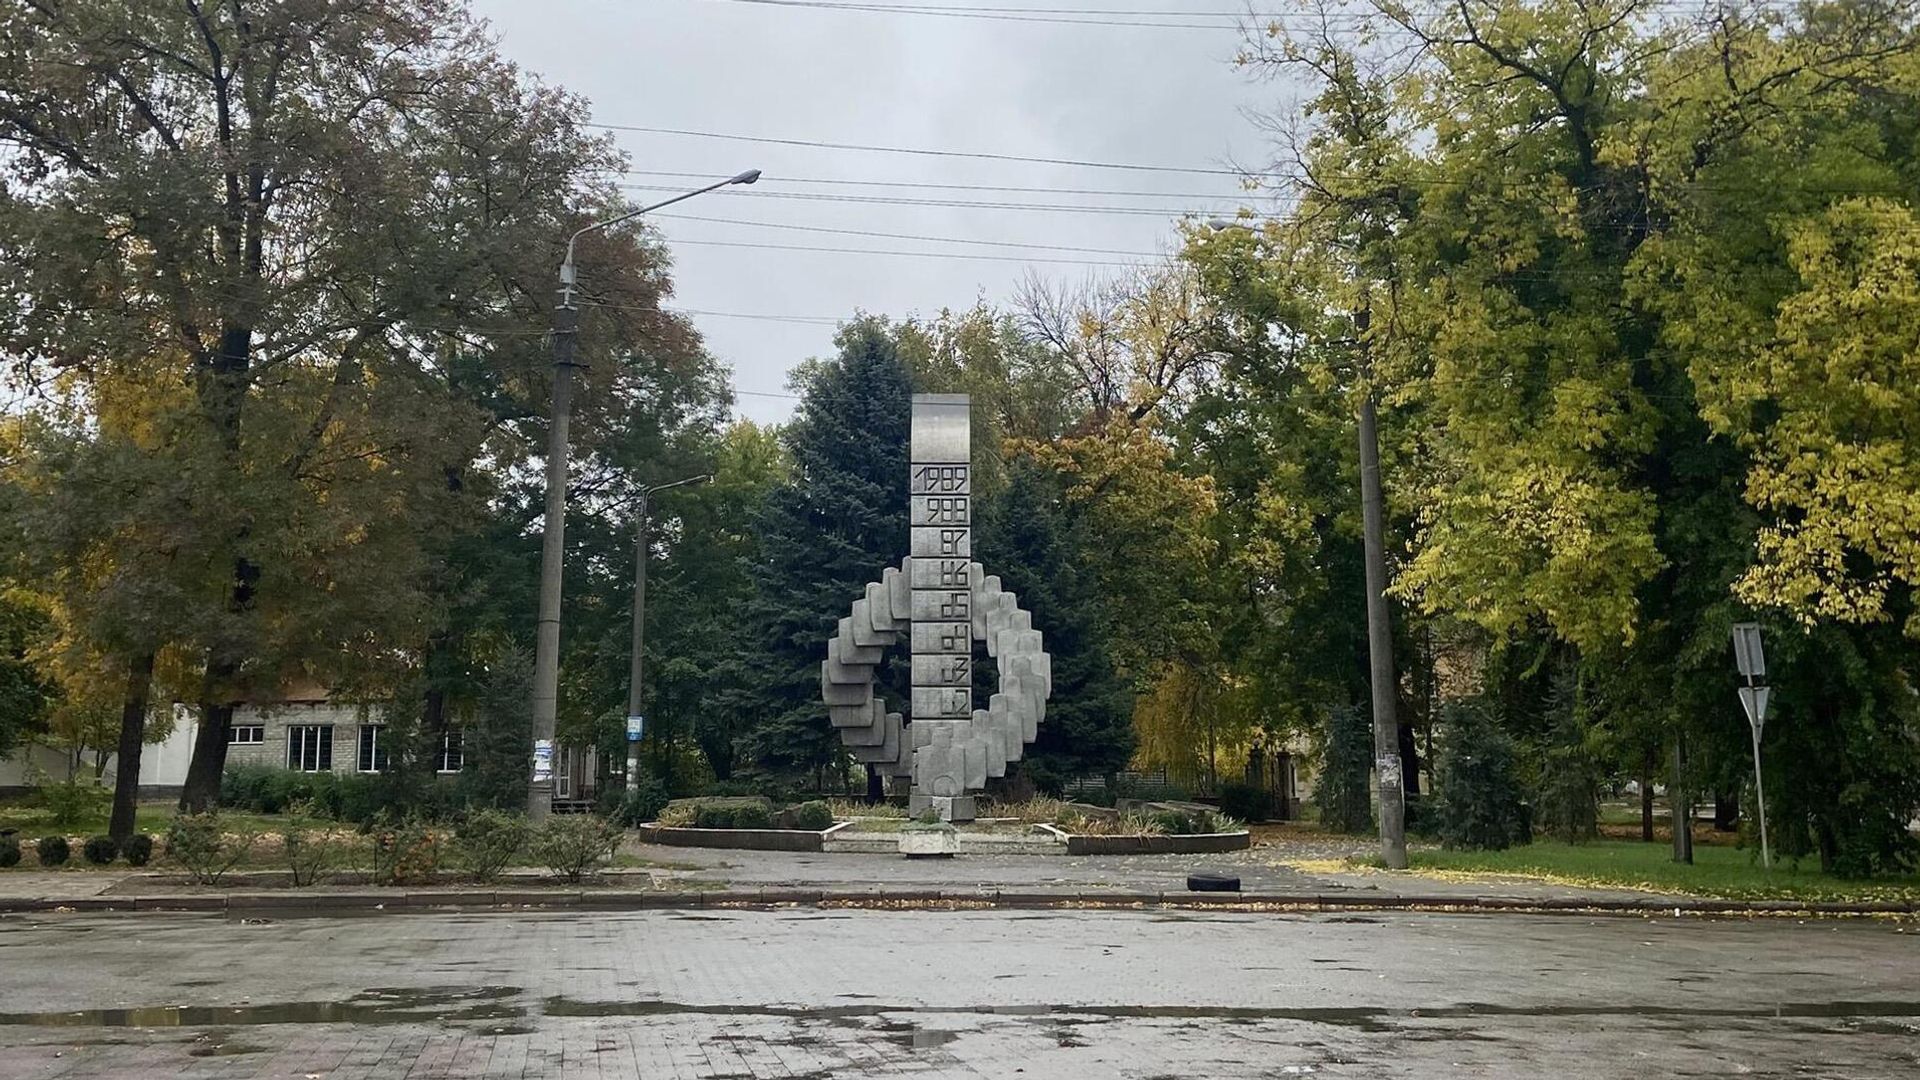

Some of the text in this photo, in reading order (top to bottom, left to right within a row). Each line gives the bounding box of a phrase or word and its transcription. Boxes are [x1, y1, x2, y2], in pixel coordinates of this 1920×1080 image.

[914, 466, 967, 491] 1989
[927, 498, 967, 522] 988
[940, 529, 967, 555] 87
